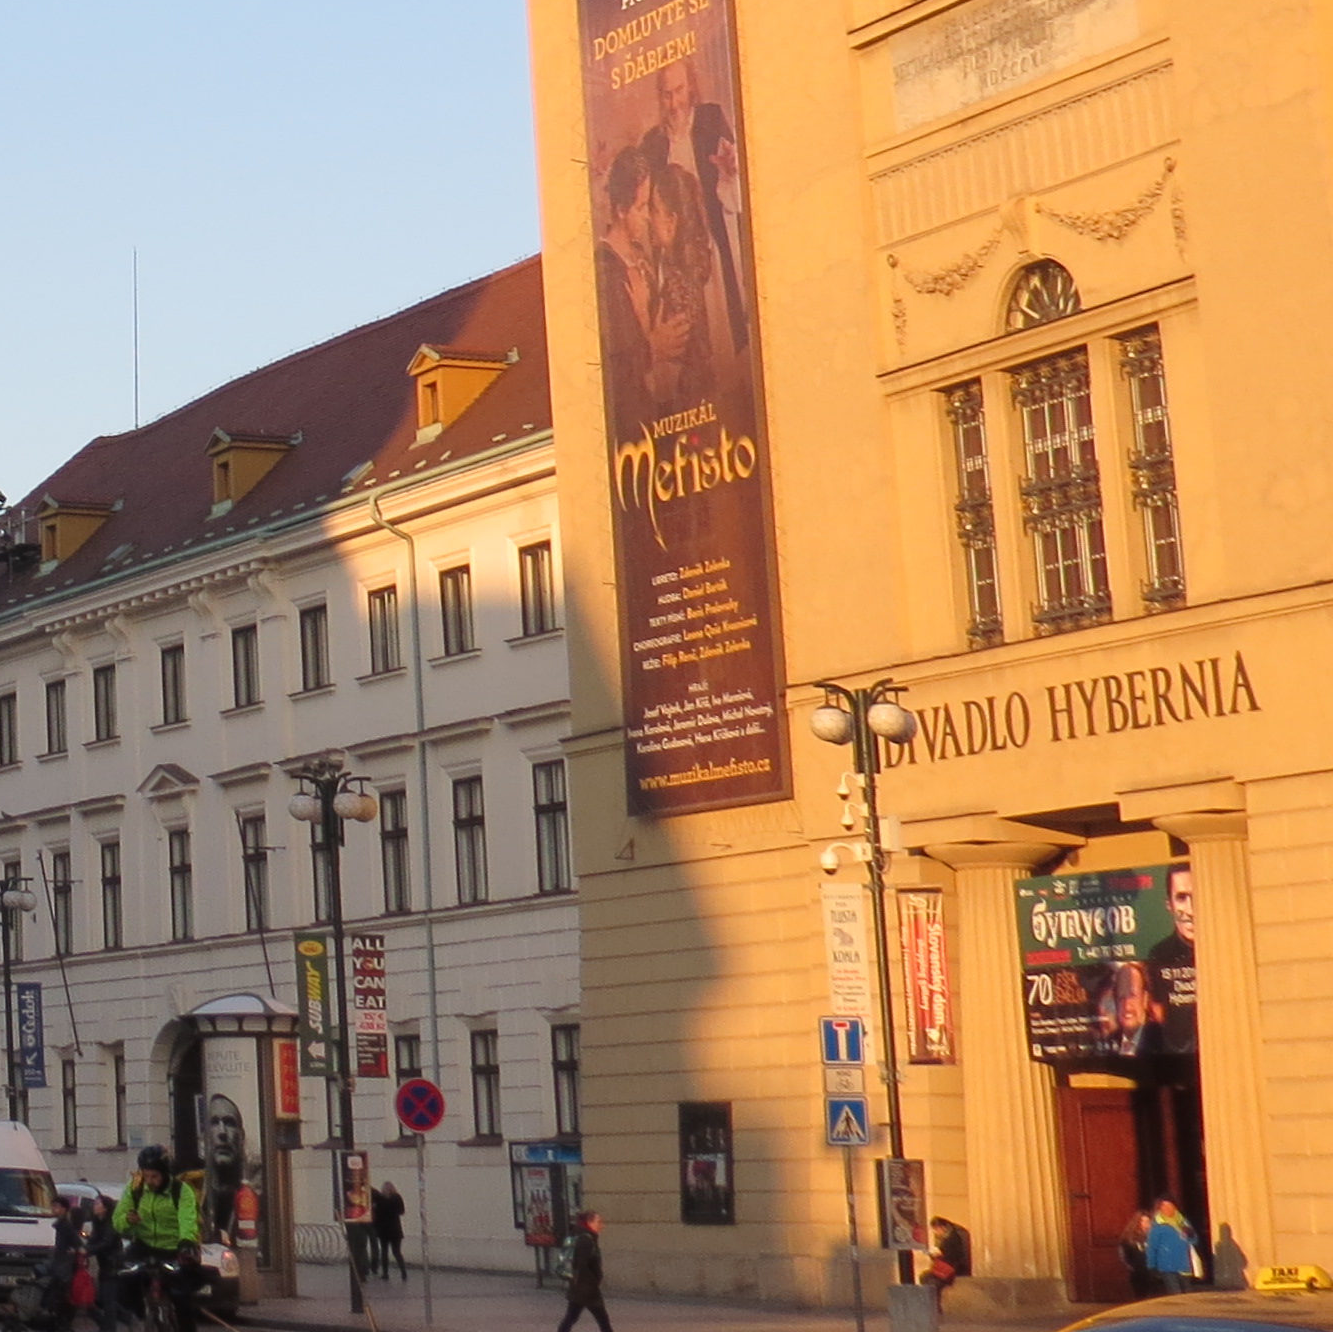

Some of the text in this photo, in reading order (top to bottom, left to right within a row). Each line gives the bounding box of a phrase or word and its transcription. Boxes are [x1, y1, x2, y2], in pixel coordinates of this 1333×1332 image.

[593, 0, 685, 61] DOMLUVTE
[611, 30, 697, 90] S ĎÁBLEM!
[652, 398, 717, 438] MUZIKÁL
[614, 420, 755, 553] Mefisto
[1045, 650, 1262, 742] HYBERNIA
[352, 938, 385, 951] ALL
[352, 957, 385, 970] YOU
[927, 923, 947, 1025] Slovanský dom
[305, 960, 324, 1035] SUBWAY
[354, 976, 386, 989] CAN
[355, 995, 387, 1008] EAT
